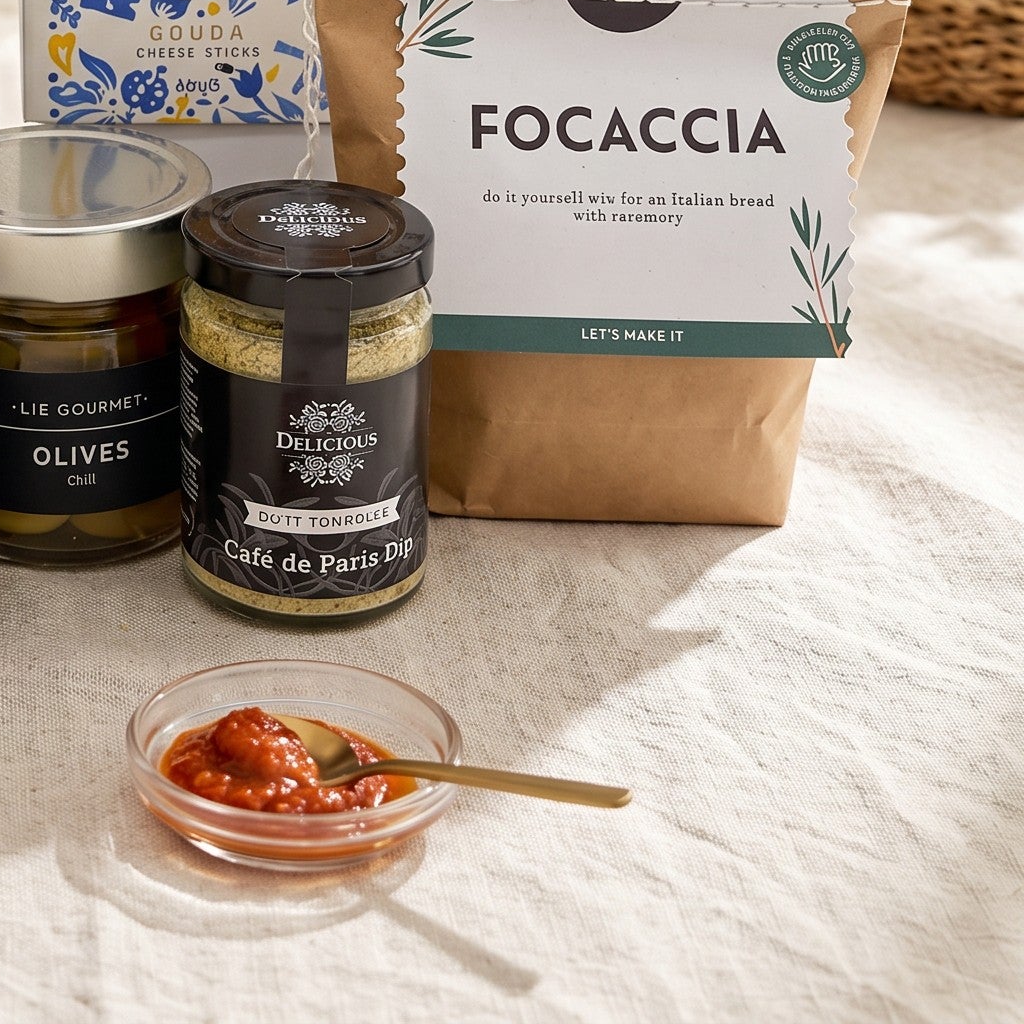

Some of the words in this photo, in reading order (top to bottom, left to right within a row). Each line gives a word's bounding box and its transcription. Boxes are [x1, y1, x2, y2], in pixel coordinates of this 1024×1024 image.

[149, 25, 244, 41] GOUDA
[136, 47, 195, 59] CHEESE
[205, 47, 260, 59] STICKS
[470, 104, 787, 156] FOCACCIA
[482, 190, 501, 204] do
[505, 190, 517, 204] it
[621, 191, 643, 206] for
[648, 195, 666, 206] an
[671, 192, 725, 207] Italian
[729, 193, 775, 208] bread
[573, 209, 607, 222] with
[611, 212, 684, 227] raremory
[581, 328, 620, 341] LET'S
[624, 329, 666, 342] MAKE
[670, 330, 684, 342] IT
[276, 431, 378, 452] DELICIOUS
[32, 440, 129, 466] OLIVES
[67, 473, 97, 486] Chill
[224, 539, 274, 570] Café
[282, 553, 311, 574] de
[319, 550, 379, 575] Paris
[383, 536, 414, 565] Dip
